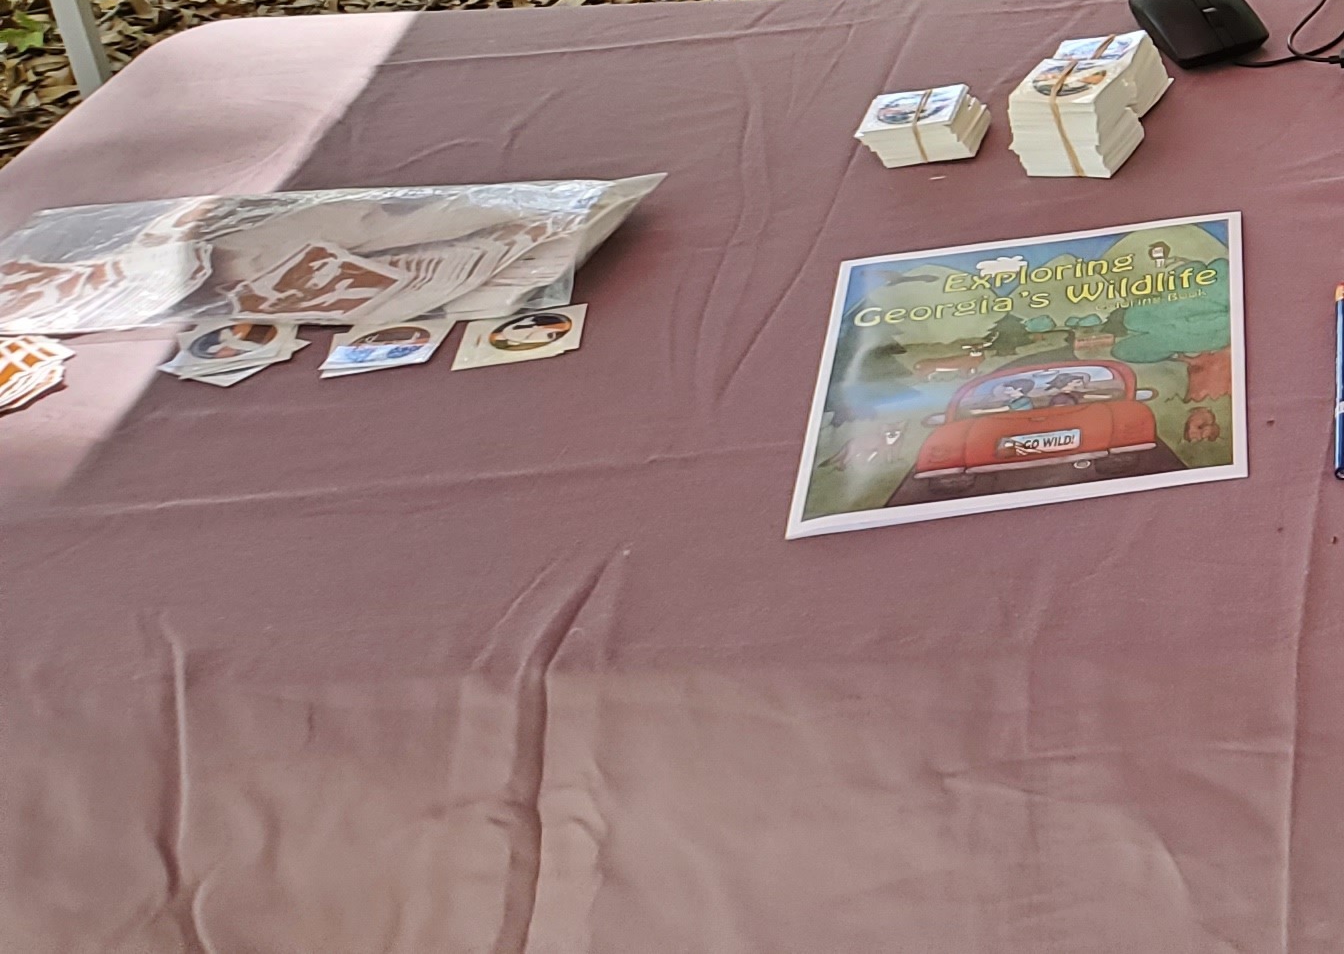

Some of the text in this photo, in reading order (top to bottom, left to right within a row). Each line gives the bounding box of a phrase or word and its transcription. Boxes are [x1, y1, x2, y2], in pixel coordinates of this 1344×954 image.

[942, 252, 1135, 294] Exploring
[853, 267, 1219, 328] Georgia's Wildlife
[1024, 434, 1075, 449] GO WILD!
